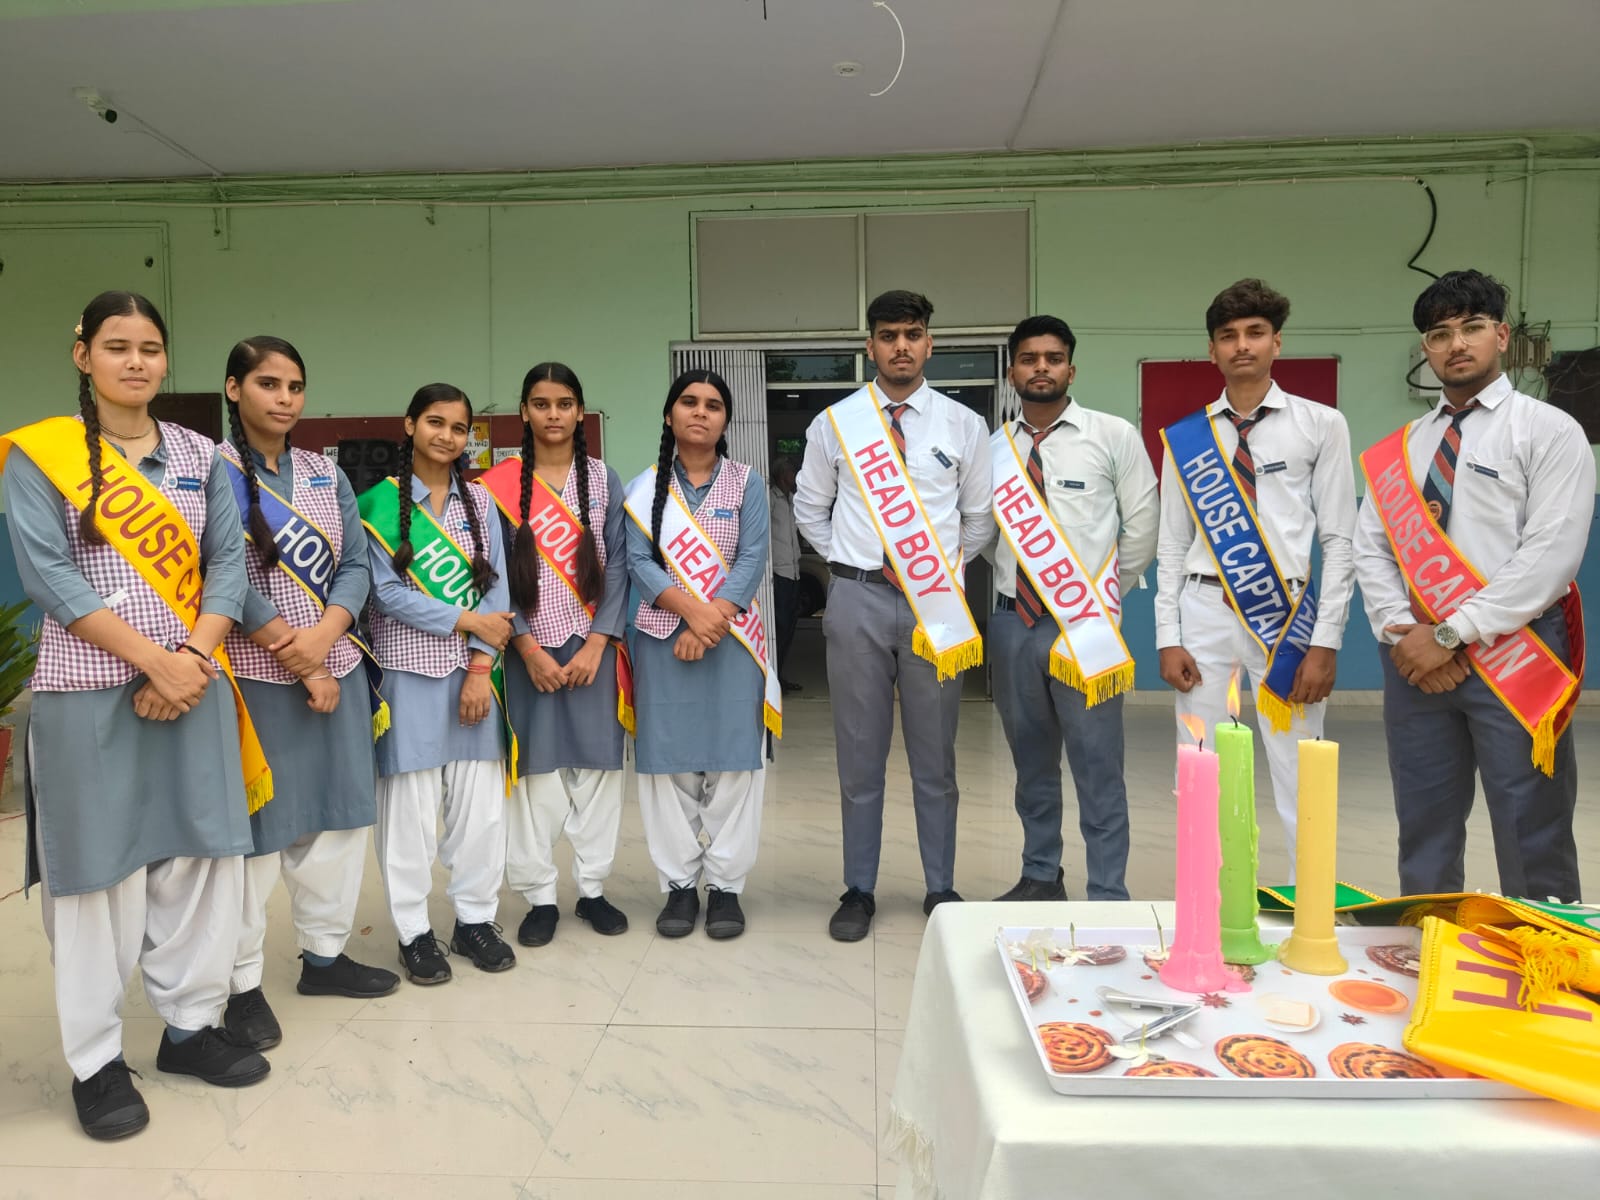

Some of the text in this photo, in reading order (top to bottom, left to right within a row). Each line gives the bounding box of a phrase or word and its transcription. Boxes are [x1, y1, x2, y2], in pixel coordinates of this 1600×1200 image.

[326, 449, 338, 457] WE
[854, 439, 951, 599] HEAD BOY
[1375, 458, 1434, 565] HOUSE
[76, 464, 193, 580] HOUSE
[993, 474, 1101, 624] HEAD BOY
[1182, 447, 1287, 645] HOUSE CAPTAI
